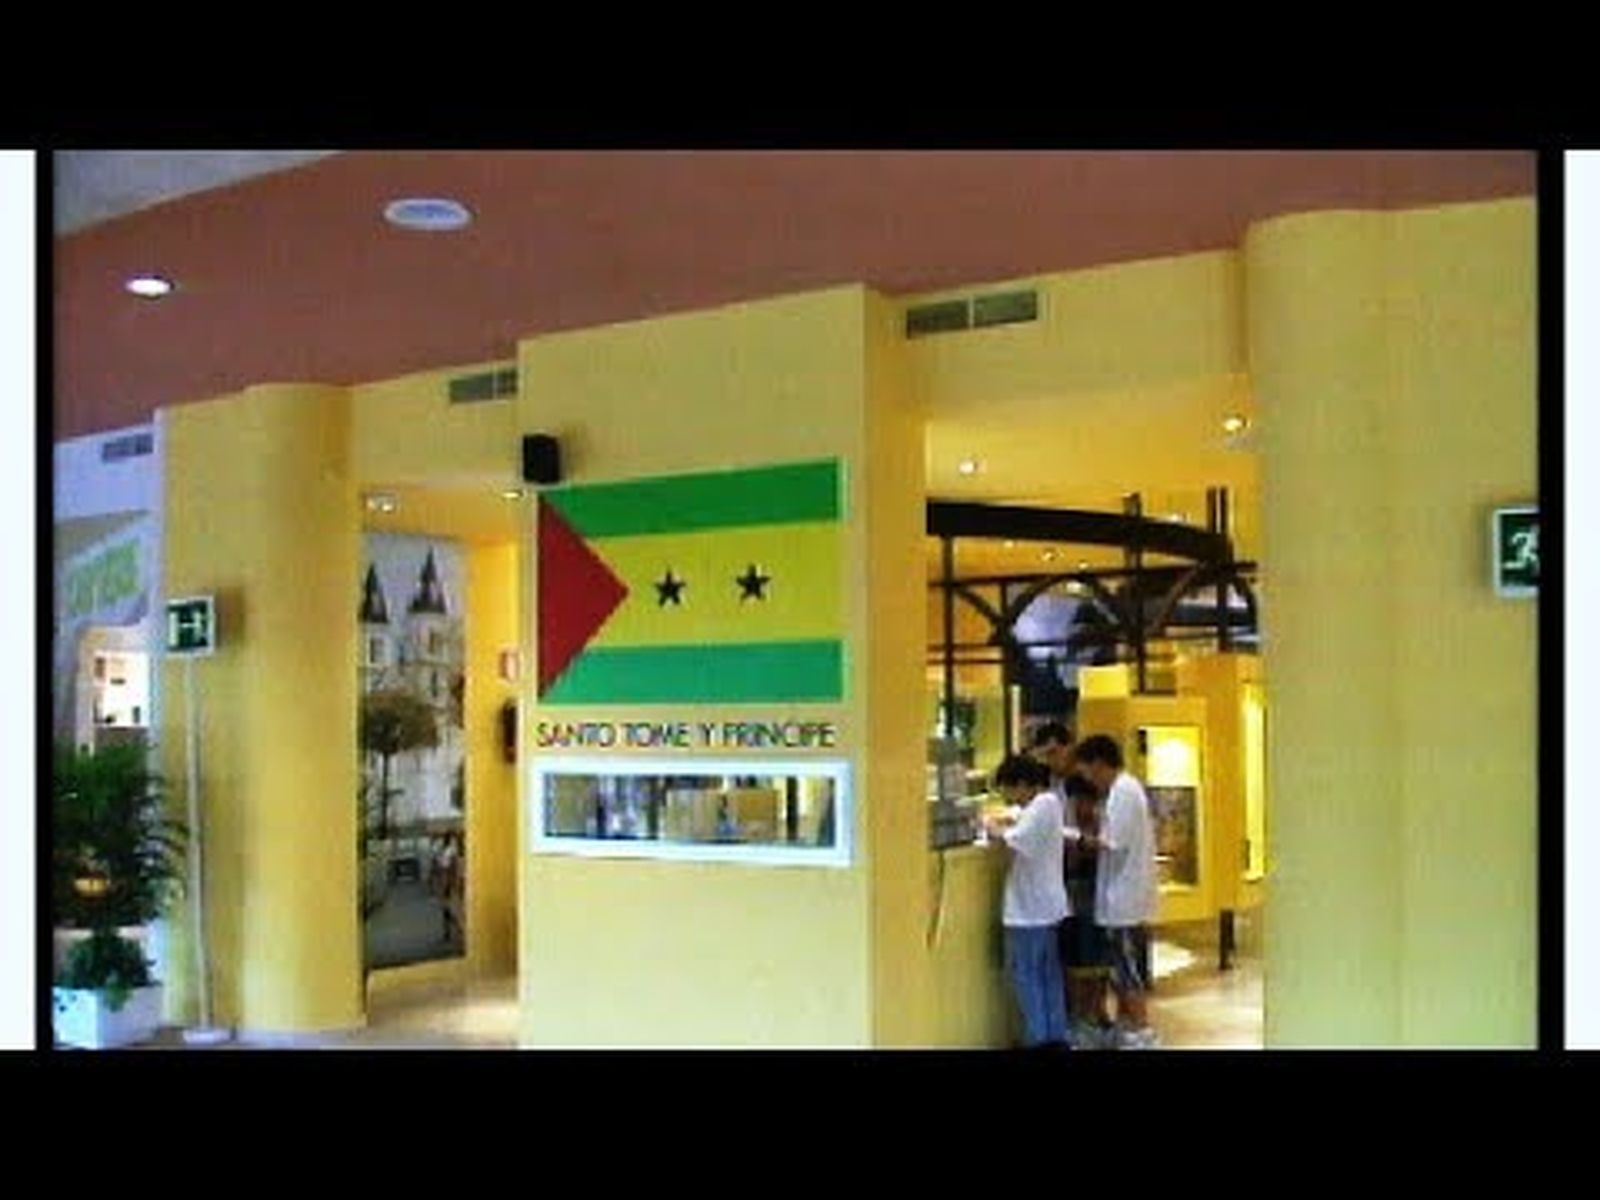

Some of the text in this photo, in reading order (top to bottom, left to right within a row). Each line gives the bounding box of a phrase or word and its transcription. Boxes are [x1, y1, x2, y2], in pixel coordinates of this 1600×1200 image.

[536, 721, 836, 748] SANTO TOME Y PRINCIPE
